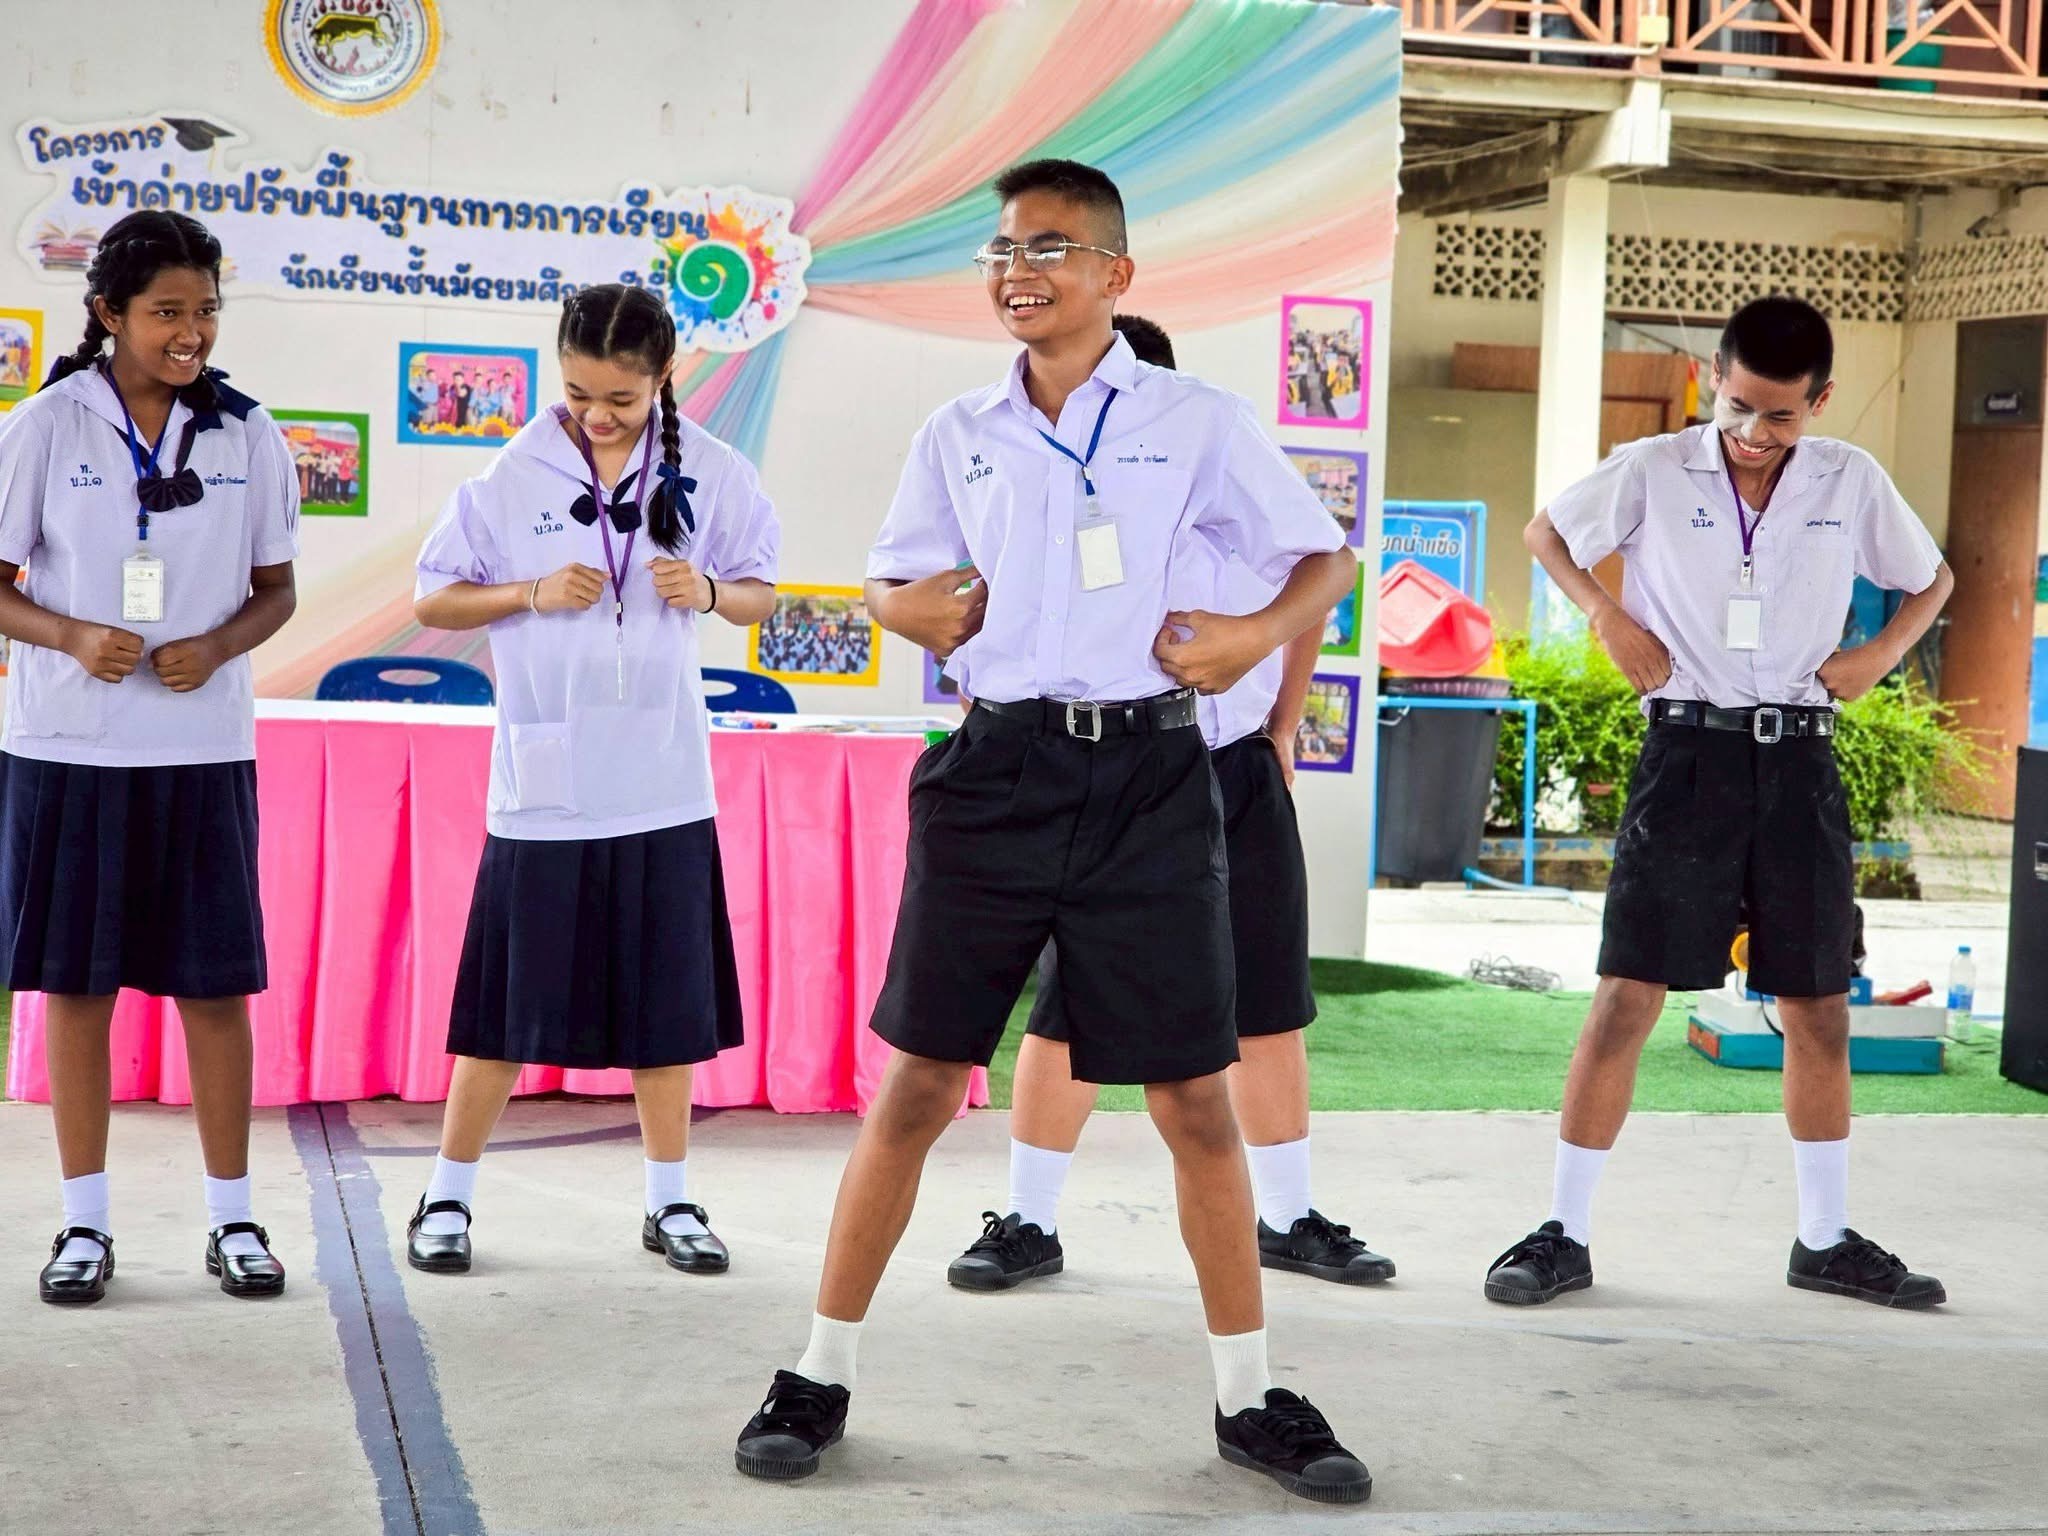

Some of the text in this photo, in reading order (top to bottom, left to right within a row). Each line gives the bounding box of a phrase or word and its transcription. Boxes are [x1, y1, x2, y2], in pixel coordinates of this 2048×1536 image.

[28, 125, 166, 163] โครงการ
[71, 152, 711, 240] เข้าค่ายปรับพื้นฐานทางการเรียน
